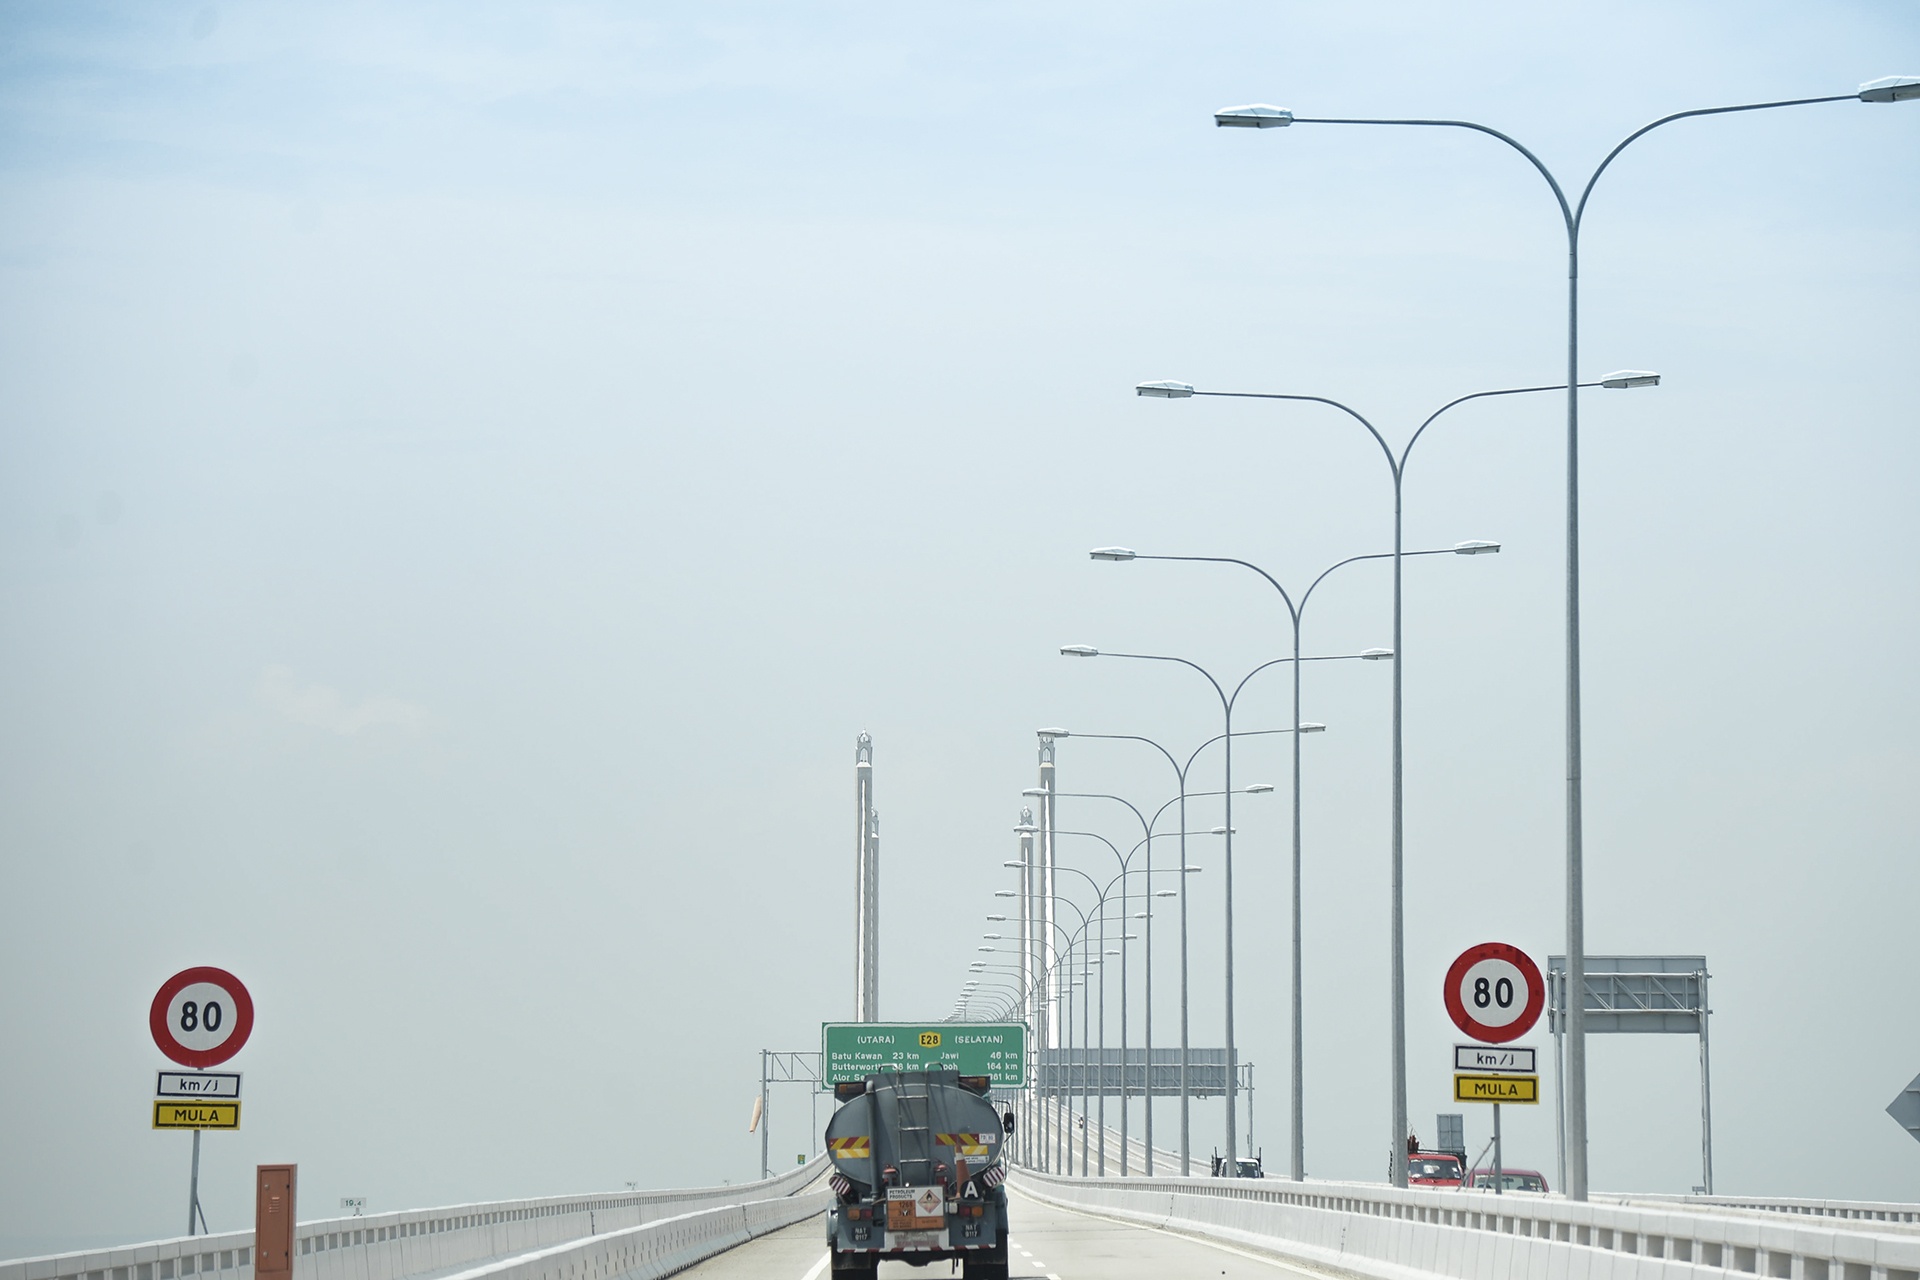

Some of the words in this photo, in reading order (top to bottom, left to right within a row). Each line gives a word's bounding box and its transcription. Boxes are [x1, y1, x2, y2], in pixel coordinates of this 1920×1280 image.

[1474, 977, 1514, 1008] 80
[180, 1001, 222, 1032] 80
[857, 1035, 895, 1044] (UTARA)
[921, 1035, 939, 1045] E28
[954, 1035, 1003, 1044] (SELATAN)
[831, 1052, 852, 1060] Batu
[854, 1052, 882, 1060] Kawan
[892, 1052, 904, 1060] 23
[907, 1052, 919, 1060] km
[940, 1052, 959, 1060] Jawi
[1005, 1052, 1018, 1060] km
[1476, 1052, 1514, 1066] km/j
[907, 1063, 919, 1071] km
[943, 1063, 958, 1071] poh
[986, 1063, 1001, 1071] 164
[1005, 1063, 1018, 1071] km
[832, 1073, 850, 1082] Alor
[1005, 1073, 1018, 1081] km
[180, 1078, 219, 1091] km/j
[1474, 1083, 1518, 1096] MULA
[174, 1109, 219, 1122] MULA
[964, 1181, 979, 1198] A
[345, 1199, 362, 1207] 19.4
